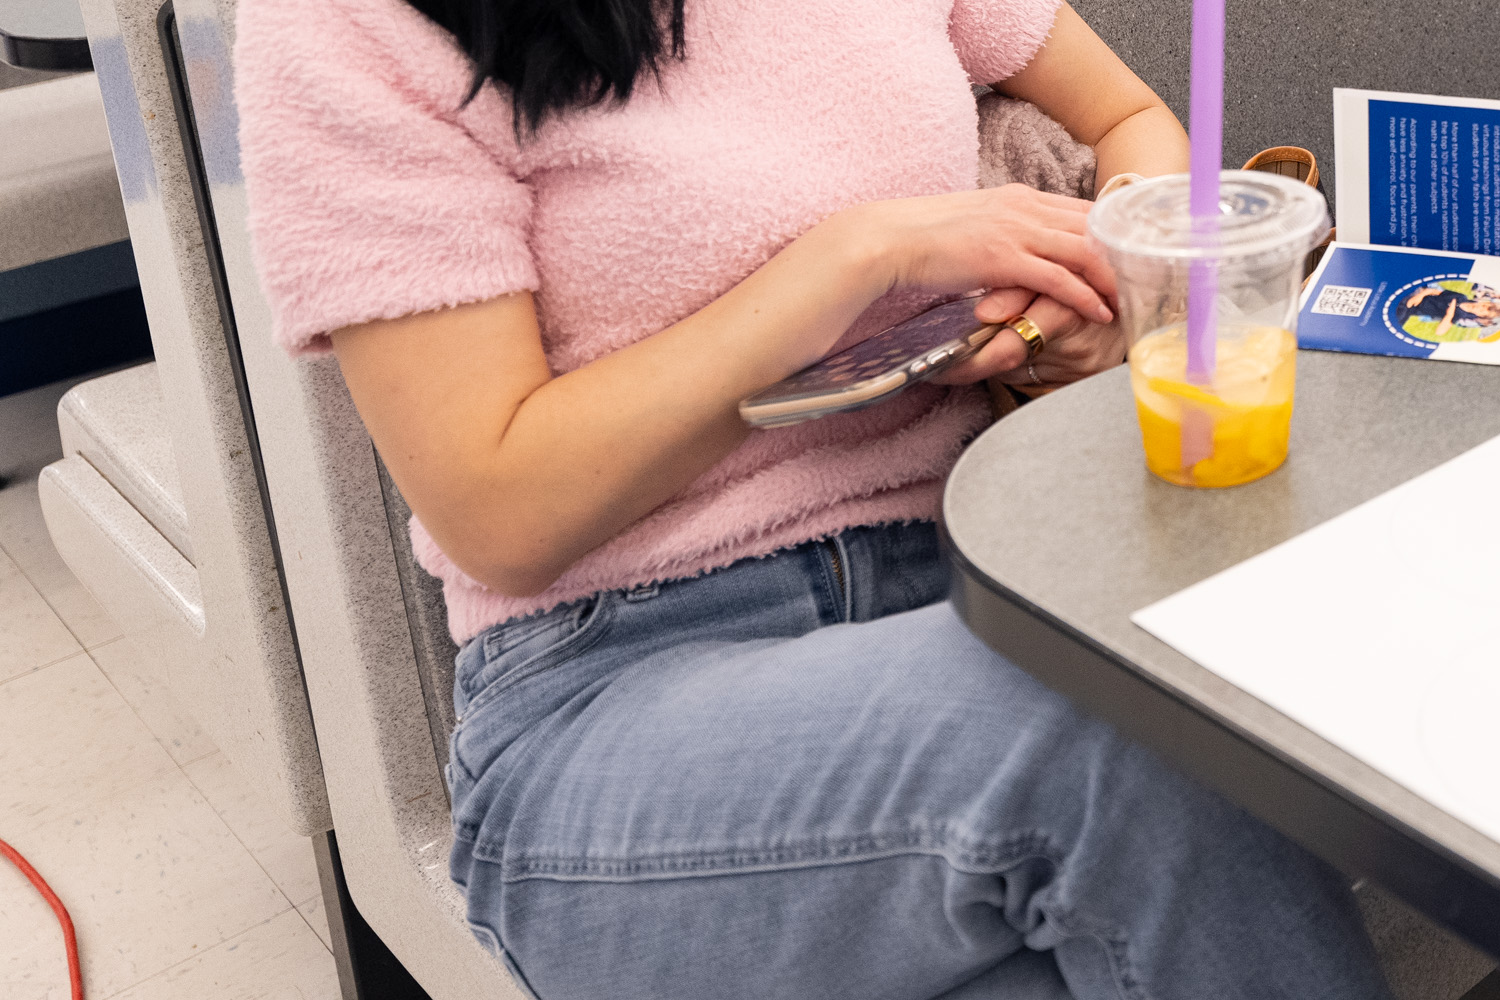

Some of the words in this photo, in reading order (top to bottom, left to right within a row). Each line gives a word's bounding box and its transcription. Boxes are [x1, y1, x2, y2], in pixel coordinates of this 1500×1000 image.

[1409, 118, 1417, 158] According
[1440, 136, 1448, 150] top
[1493, 125, 1500, 163] introduce
[1399, 154, 1407, 182] anxiety
[1410, 160, 1417, 168] to
[1441, 167, 1448, 175] of
[1472, 159, 1480, 168] of
[1452, 179, 1459, 187] of
[1471, 169, 1479, 181] any
[1482, 157, 1490, 194] teachings
[1493, 164, 1500, 197] students
[1493, 199, 1500, 207] to
[1483, 216, 1491, 237] Falun
[1493, 209, 1500, 250] meditation
